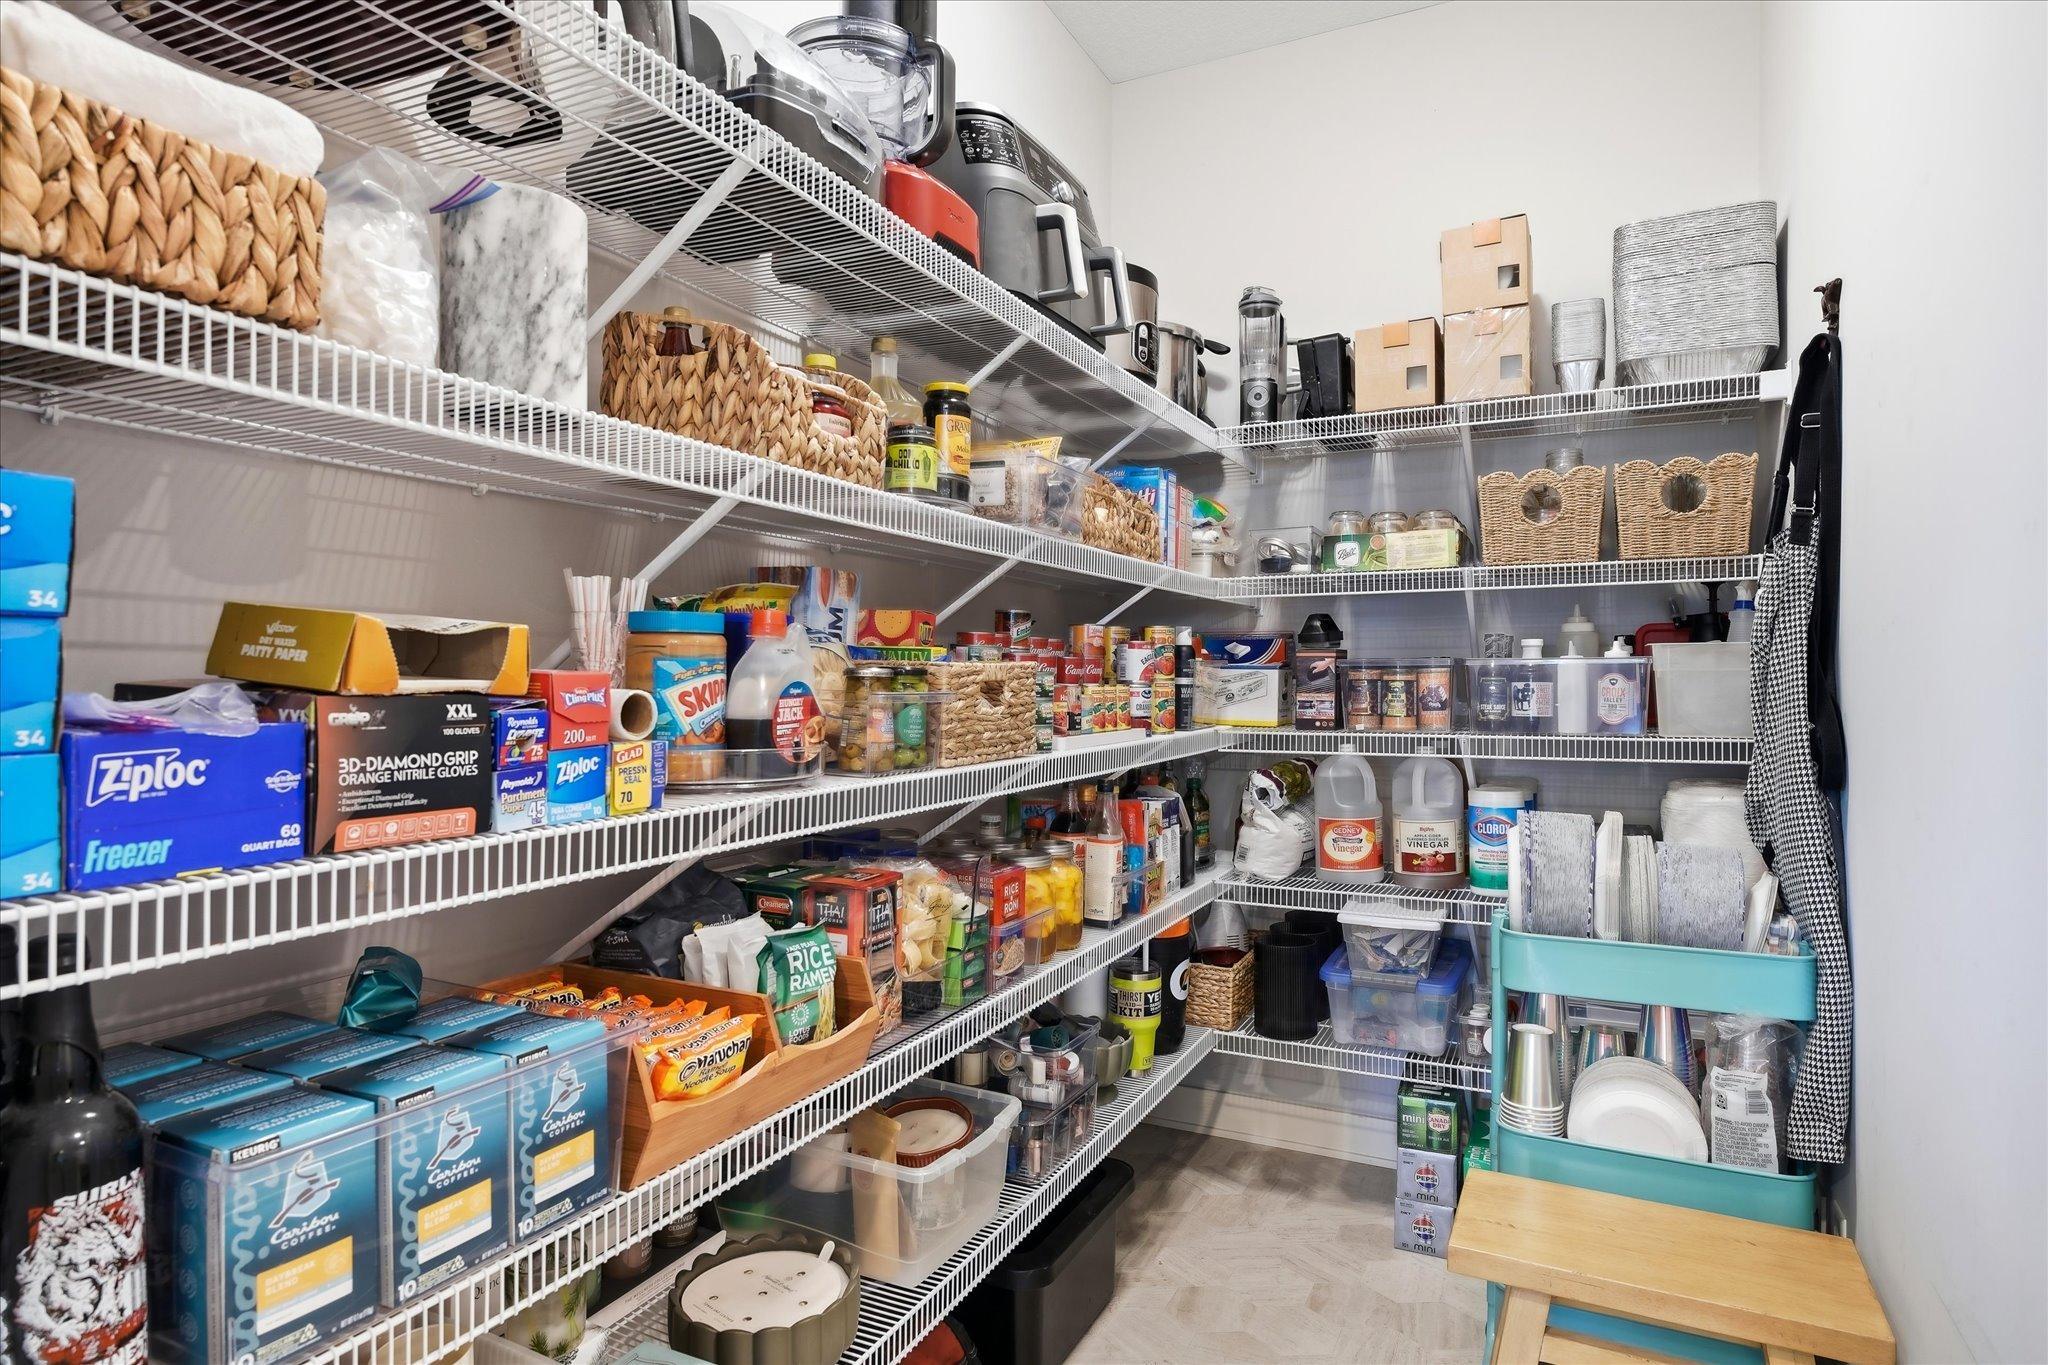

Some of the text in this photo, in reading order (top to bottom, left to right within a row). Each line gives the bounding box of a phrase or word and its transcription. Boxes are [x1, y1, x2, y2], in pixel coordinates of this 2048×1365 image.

[28, 590, 59, 607] 34
[240, 643, 309, 662] PATTY PAPER
[778, 697, 804, 708] HUNGRY
[446, 704, 478, 718] XXL
[776, 707, 804, 722] JACK
[507, 717, 539, 728] Reynolds
[442, 726, 481, 736] 100 GLOVES
[563, 728, 586, 744] 200
[14, 730, 46, 748] 34
[530, 745, 544, 757] 75
[616, 746, 643, 763] GLAD
[338, 750, 479, 774] 3D-DIAMOND GRIP
[338, 764, 479, 786] ORANGE NITRILE GLOVES
[556, 755, 600, 786] Ziploc
[618, 766, 648, 776] PRESS'N
[98, 755, 208, 802] Ziploc
[501, 776, 536, 790] Reynolds
[623, 774, 642, 785] SEAL
[375, 793, 401, 802] Diamond
[501, 788, 546, 804] Parchment
[620, 791, 633, 803] 70
[501, 803, 525, 815] Paper
[528, 800, 546, 819] 45
[592, 805, 603, 816] 10
[280, 823, 302, 838] 60
[1333, 827, 1361, 835] GEDNEY
[241, 837, 301, 853] QUART BAGS
[1332, 843, 1364, 855] Vinegar
[1406, 840, 1450, 849] VINEGAR
[84, 839, 174, 874] Freezer
[22, 874, 53, 891] 34
[1004, 882, 1019, 897] RICE
[757, 897, 791, 911] Creamette
[816, 902, 846, 919] THAI
[1003, 901, 1019, 914] RONI
[800, 940, 818, 950] PEARL
[787, 944, 834, 974] RICE
[789, 964, 838, 992] RAMEN
[1119, 991, 1143, 1003] THIRST
[1119, 1007, 1142, 1017] KIT
[788, 1025, 811, 1037] LOTUS
[696, 1037, 752, 1069] Maruchan
[714, 1065, 737, 1078] Soup
[542, 1109, 586, 1134] Caribou
[1402, 1113, 1426, 1124] mini
[1432, 1122, 1446, 1130] DRY
[550, 1121, 582, 1138] COFFEE
[233, 1139, 281, 1162] KEURIG
[427, 1156, 482, 1186] Caribou
[436, 1169, 476, 1190] COFFEE
[1415, 1175, 1438, 1183] PEPSI
[1416, 1192, 1439, 1203] mini
[270, 1212, 340, 1245] Caribou
[423, 1213, 451, 1230] BLEND
[517, 1218, 534, 1238] 10
[1413, 1225, 1435, 1235] PEPSI
[281, 1228, 333, 1250] COFFEE
[1413, 1243, 1436, 1254] mini
[264, 1277, 299, 1297] BLEND
[398, 1280, 417, 1301] 10
